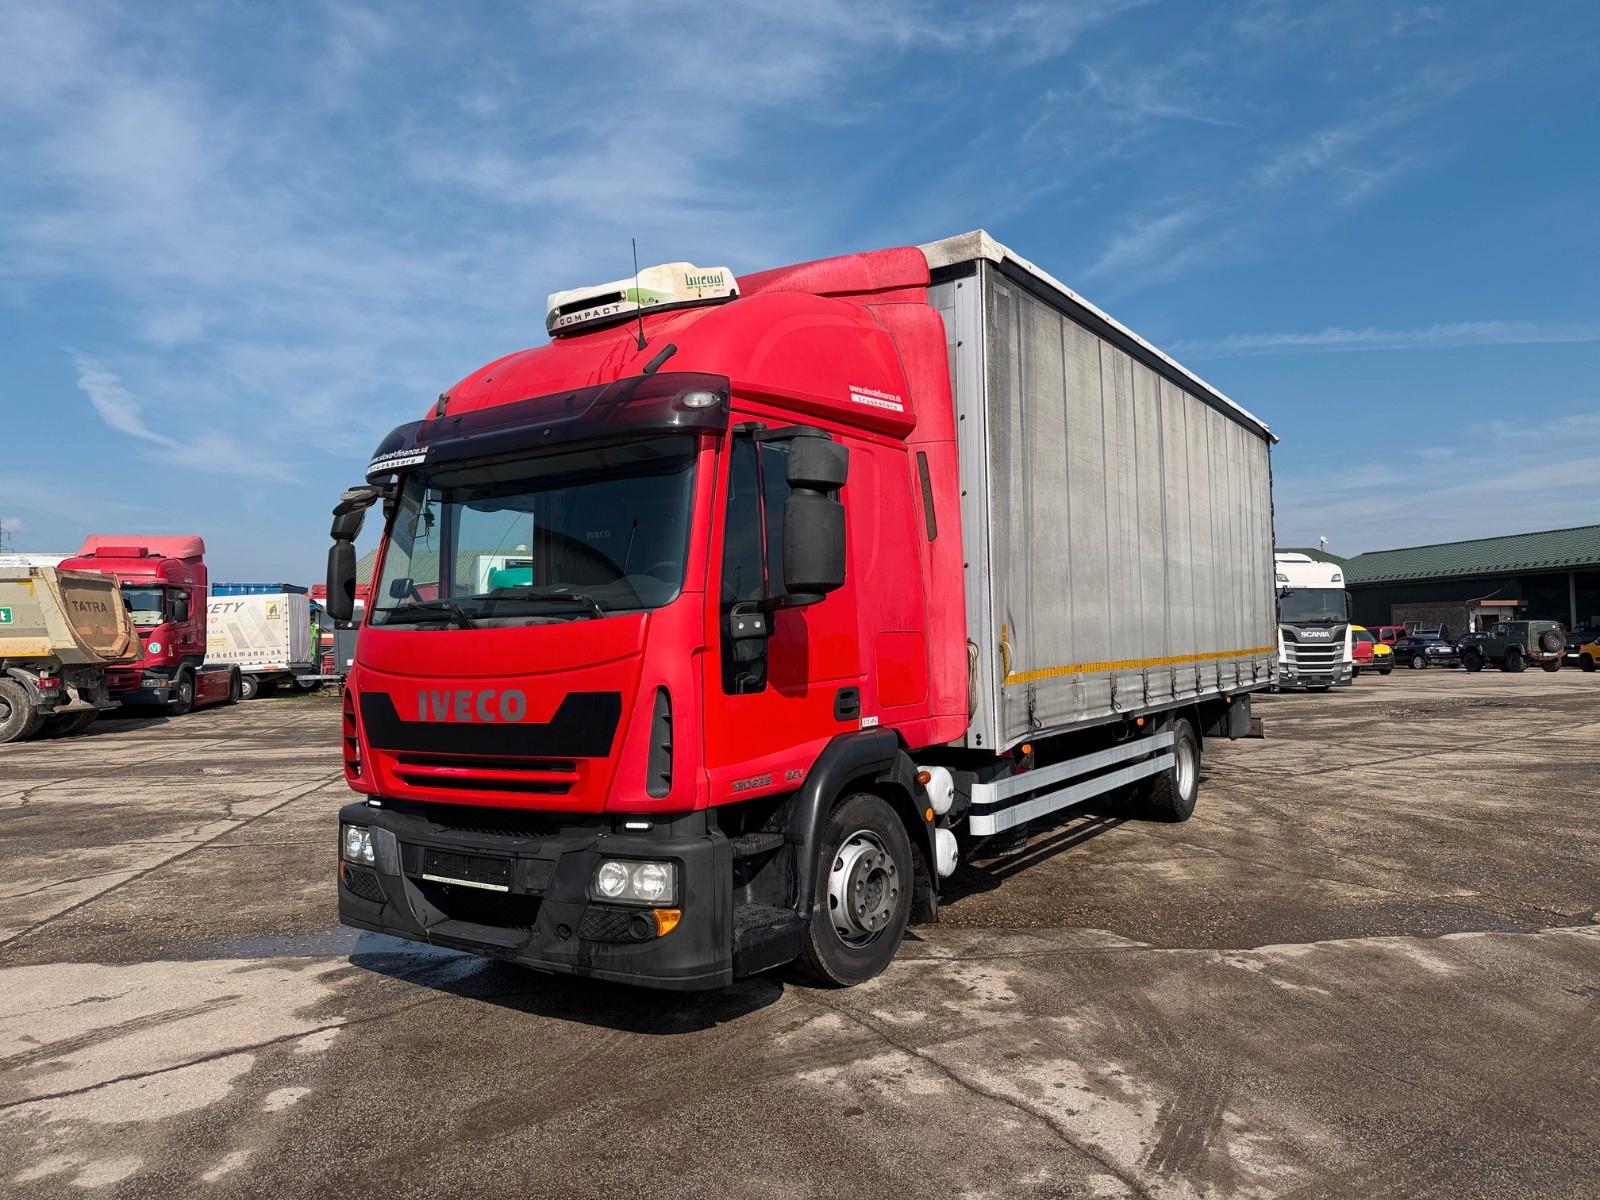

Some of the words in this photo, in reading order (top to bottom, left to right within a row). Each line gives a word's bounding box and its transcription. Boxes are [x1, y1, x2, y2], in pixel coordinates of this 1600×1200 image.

[560, 305, 620, 326] COMPACT
[72, 601, 107, 612] TATRA
[418, 689, 526, 721] IVECO
